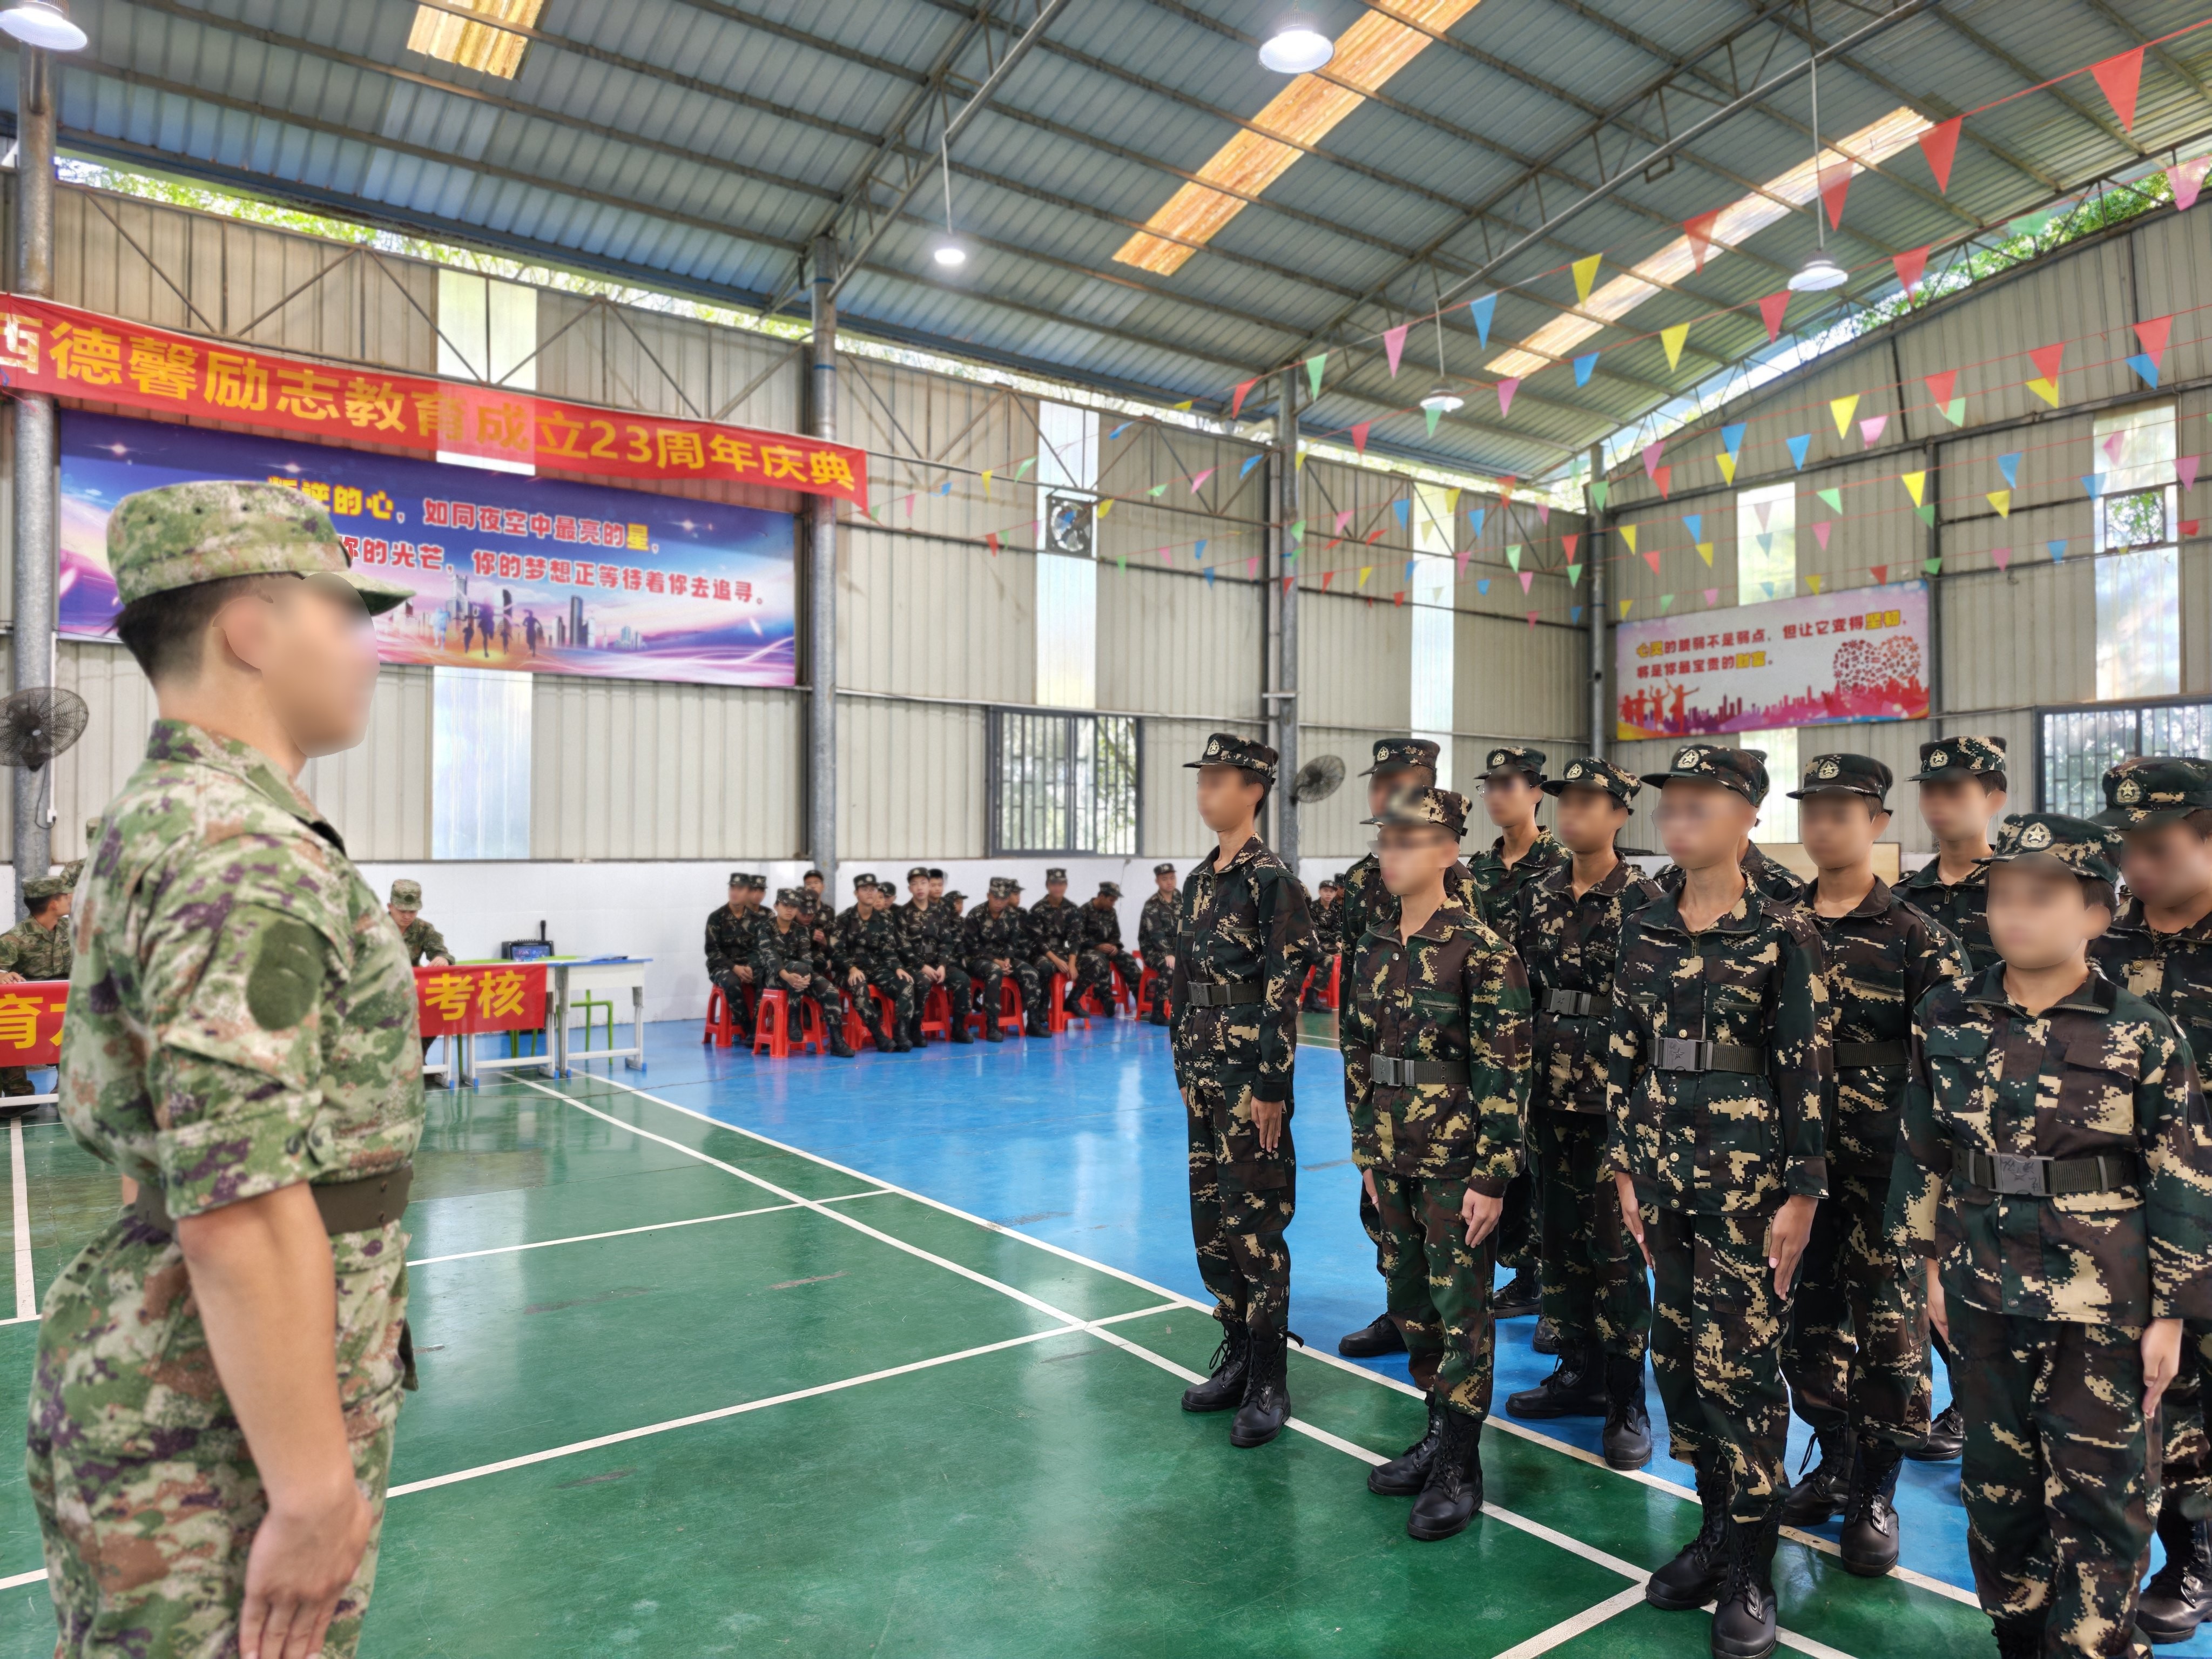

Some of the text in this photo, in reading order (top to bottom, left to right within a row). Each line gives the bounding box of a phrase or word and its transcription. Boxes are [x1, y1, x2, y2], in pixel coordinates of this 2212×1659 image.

[267, 476, 659, 554] 逆的心，如同夜空中最亮的星，
[414, 970, 526, 1021] 考核
